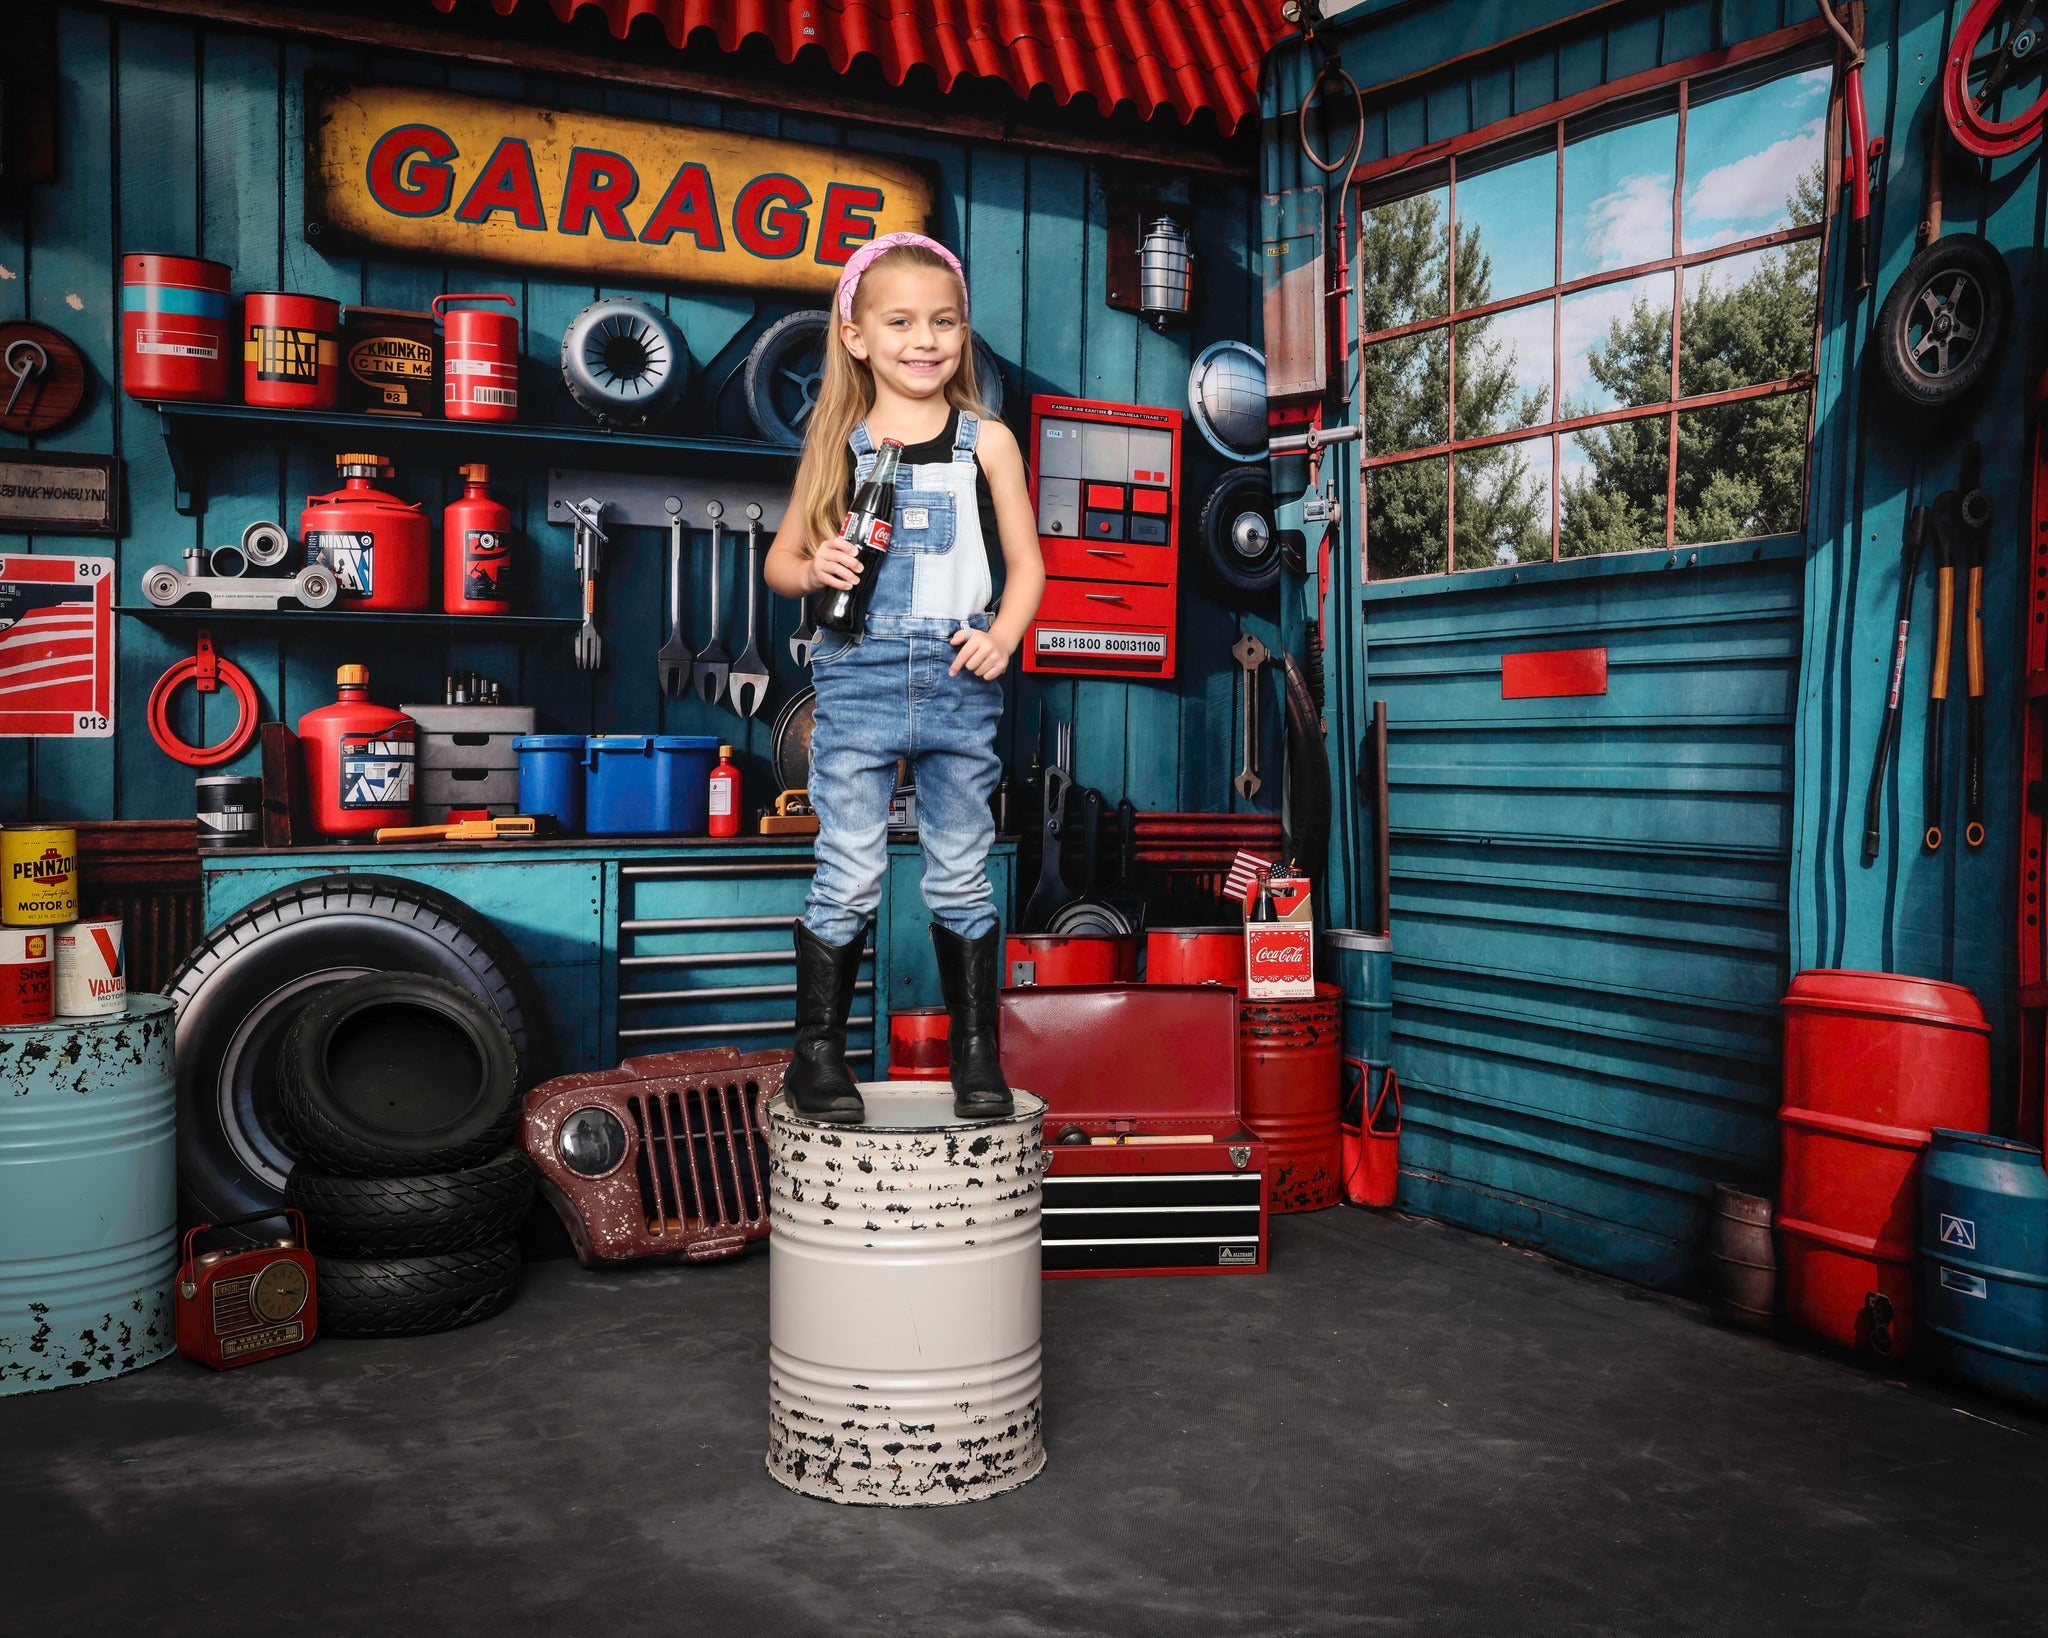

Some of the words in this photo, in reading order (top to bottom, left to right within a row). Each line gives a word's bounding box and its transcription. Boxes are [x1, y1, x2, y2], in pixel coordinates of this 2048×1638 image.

[366, 124, 884, 267] GARAGE
[79, 564, 101, 576] 80
[1051, 636, 1066, 648] 88
[1105, 640, 1161, 652] 800131100
[79, 716, 107, 729] 013
[18, 901, 62, 911] MOTOR
[20, 966, 49, 980] Shell
[17, 983, 28, 995] X
[31, 981, 50, 995] 100
